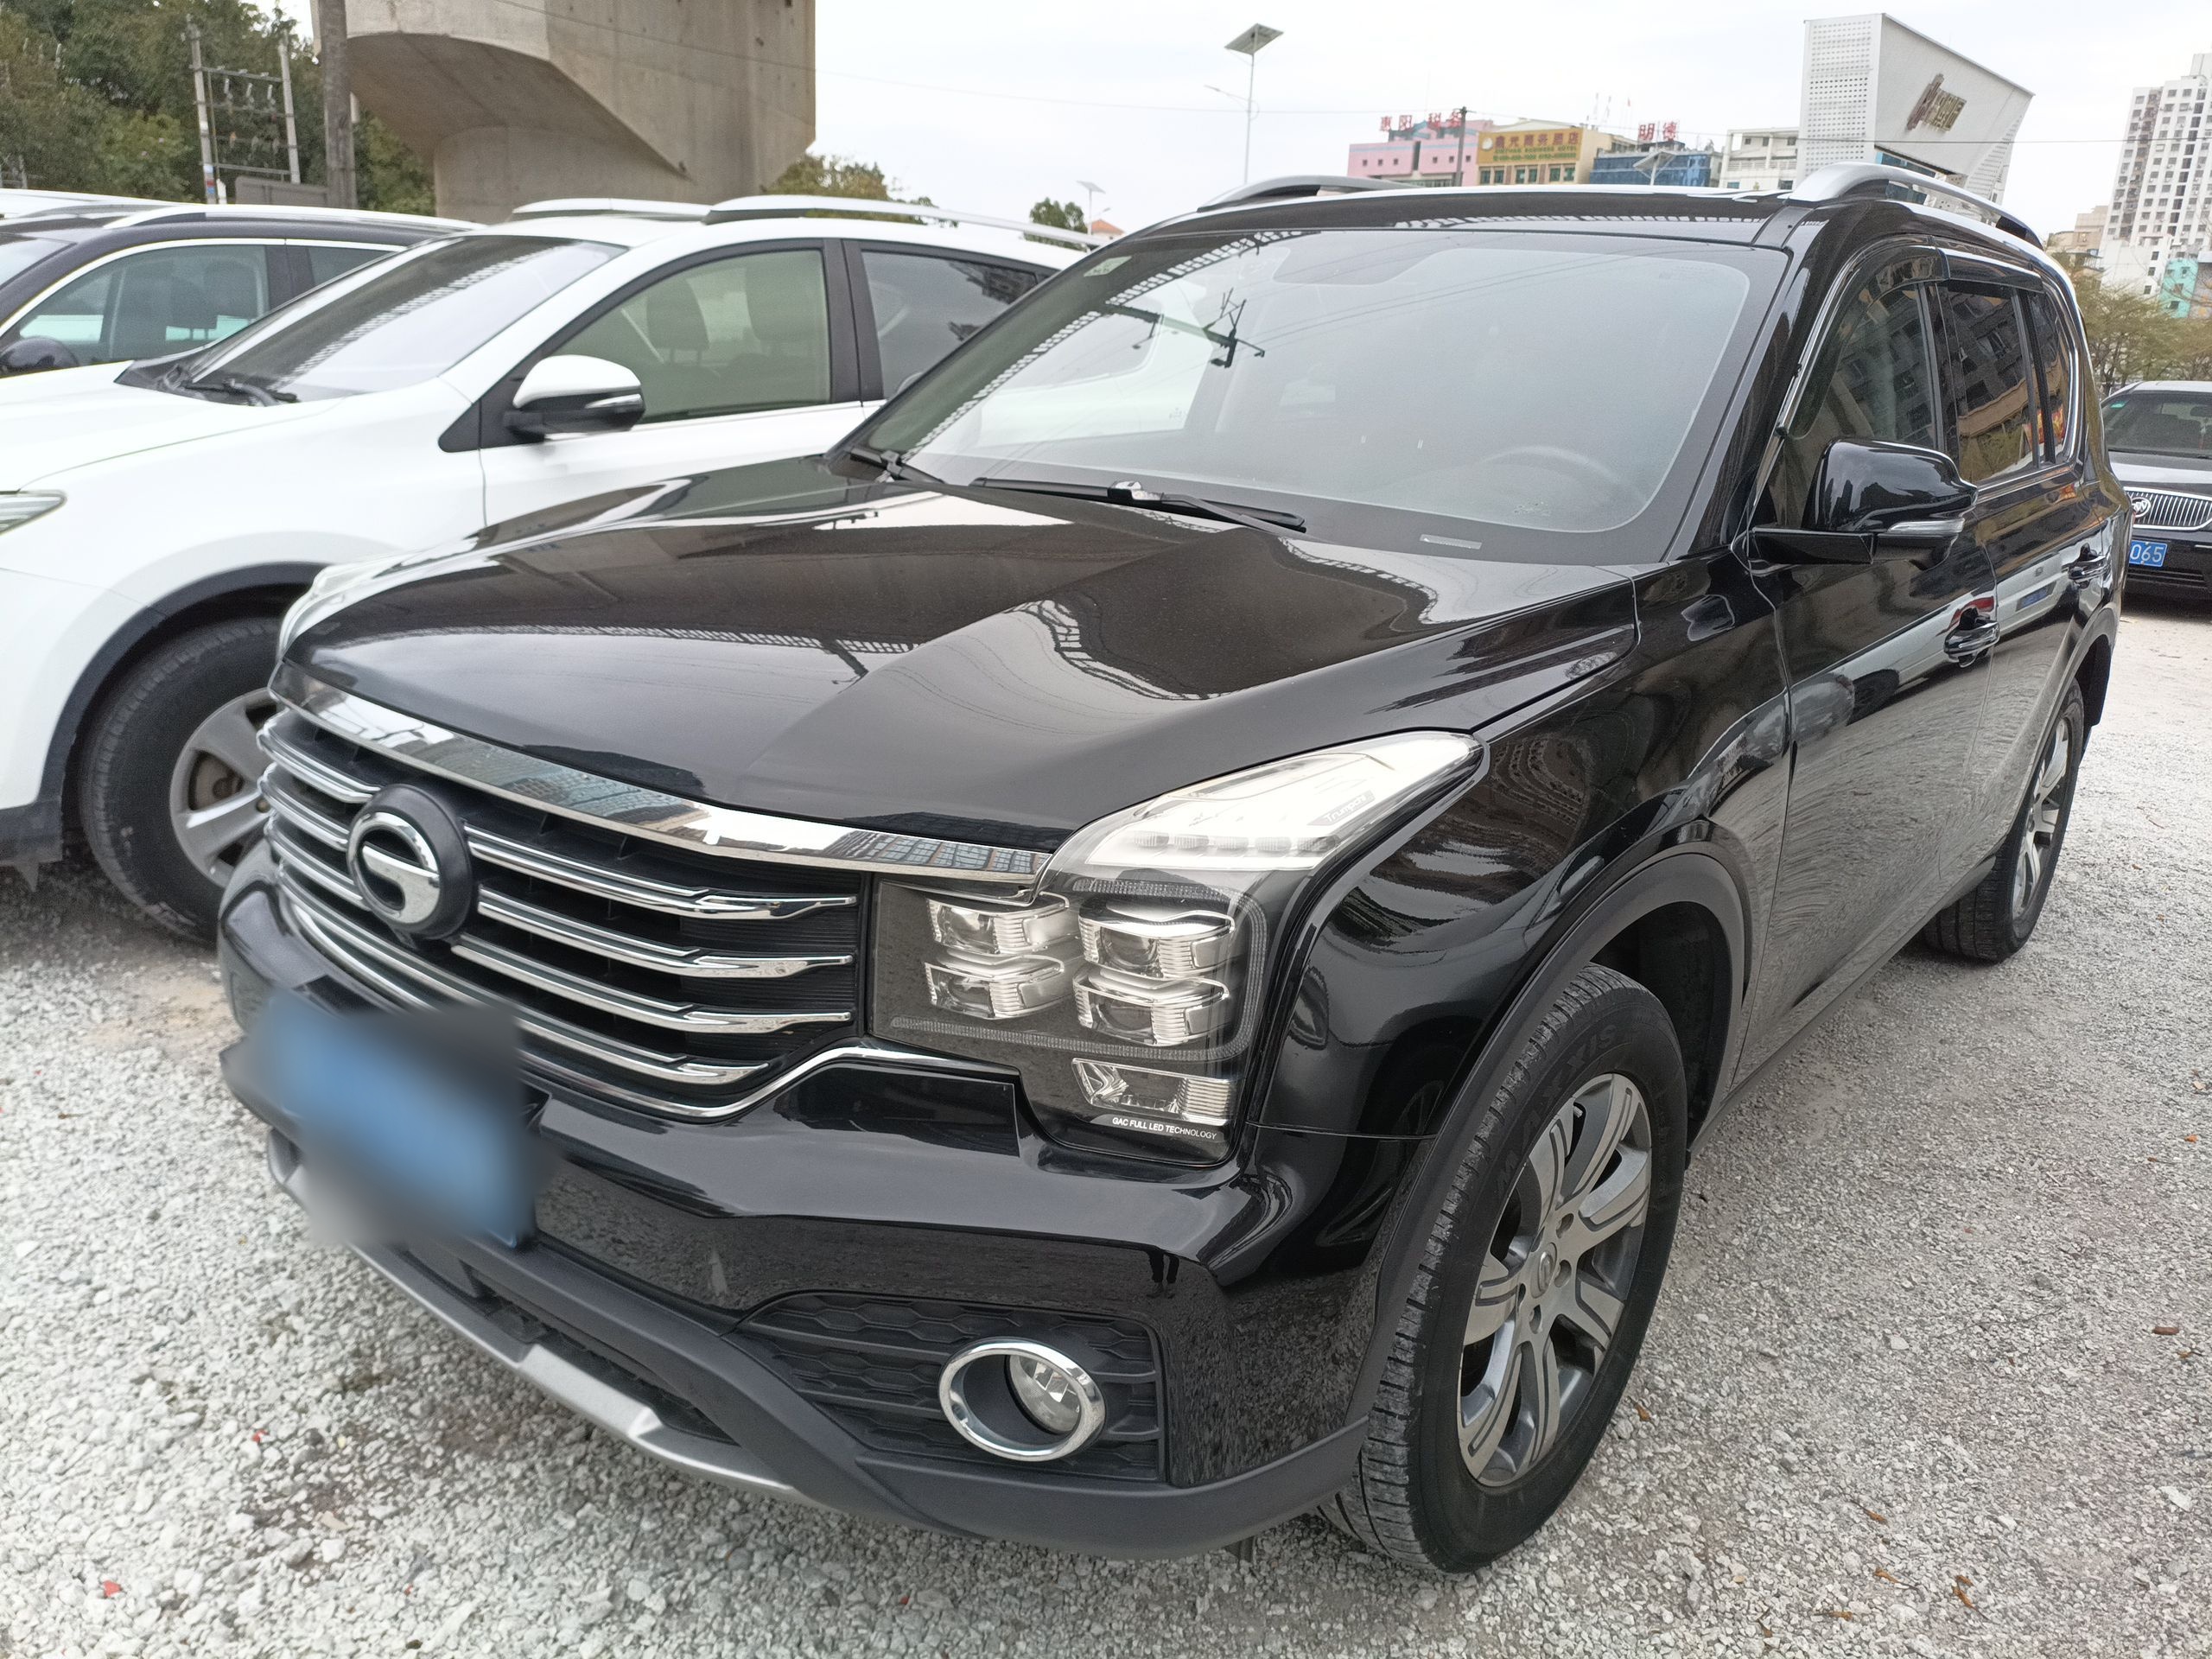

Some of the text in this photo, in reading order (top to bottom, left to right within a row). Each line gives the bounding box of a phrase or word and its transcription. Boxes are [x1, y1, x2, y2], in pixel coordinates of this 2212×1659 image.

[1112, 1116, 1217, 1140] GAC FULL LED TECHNOLOGY
